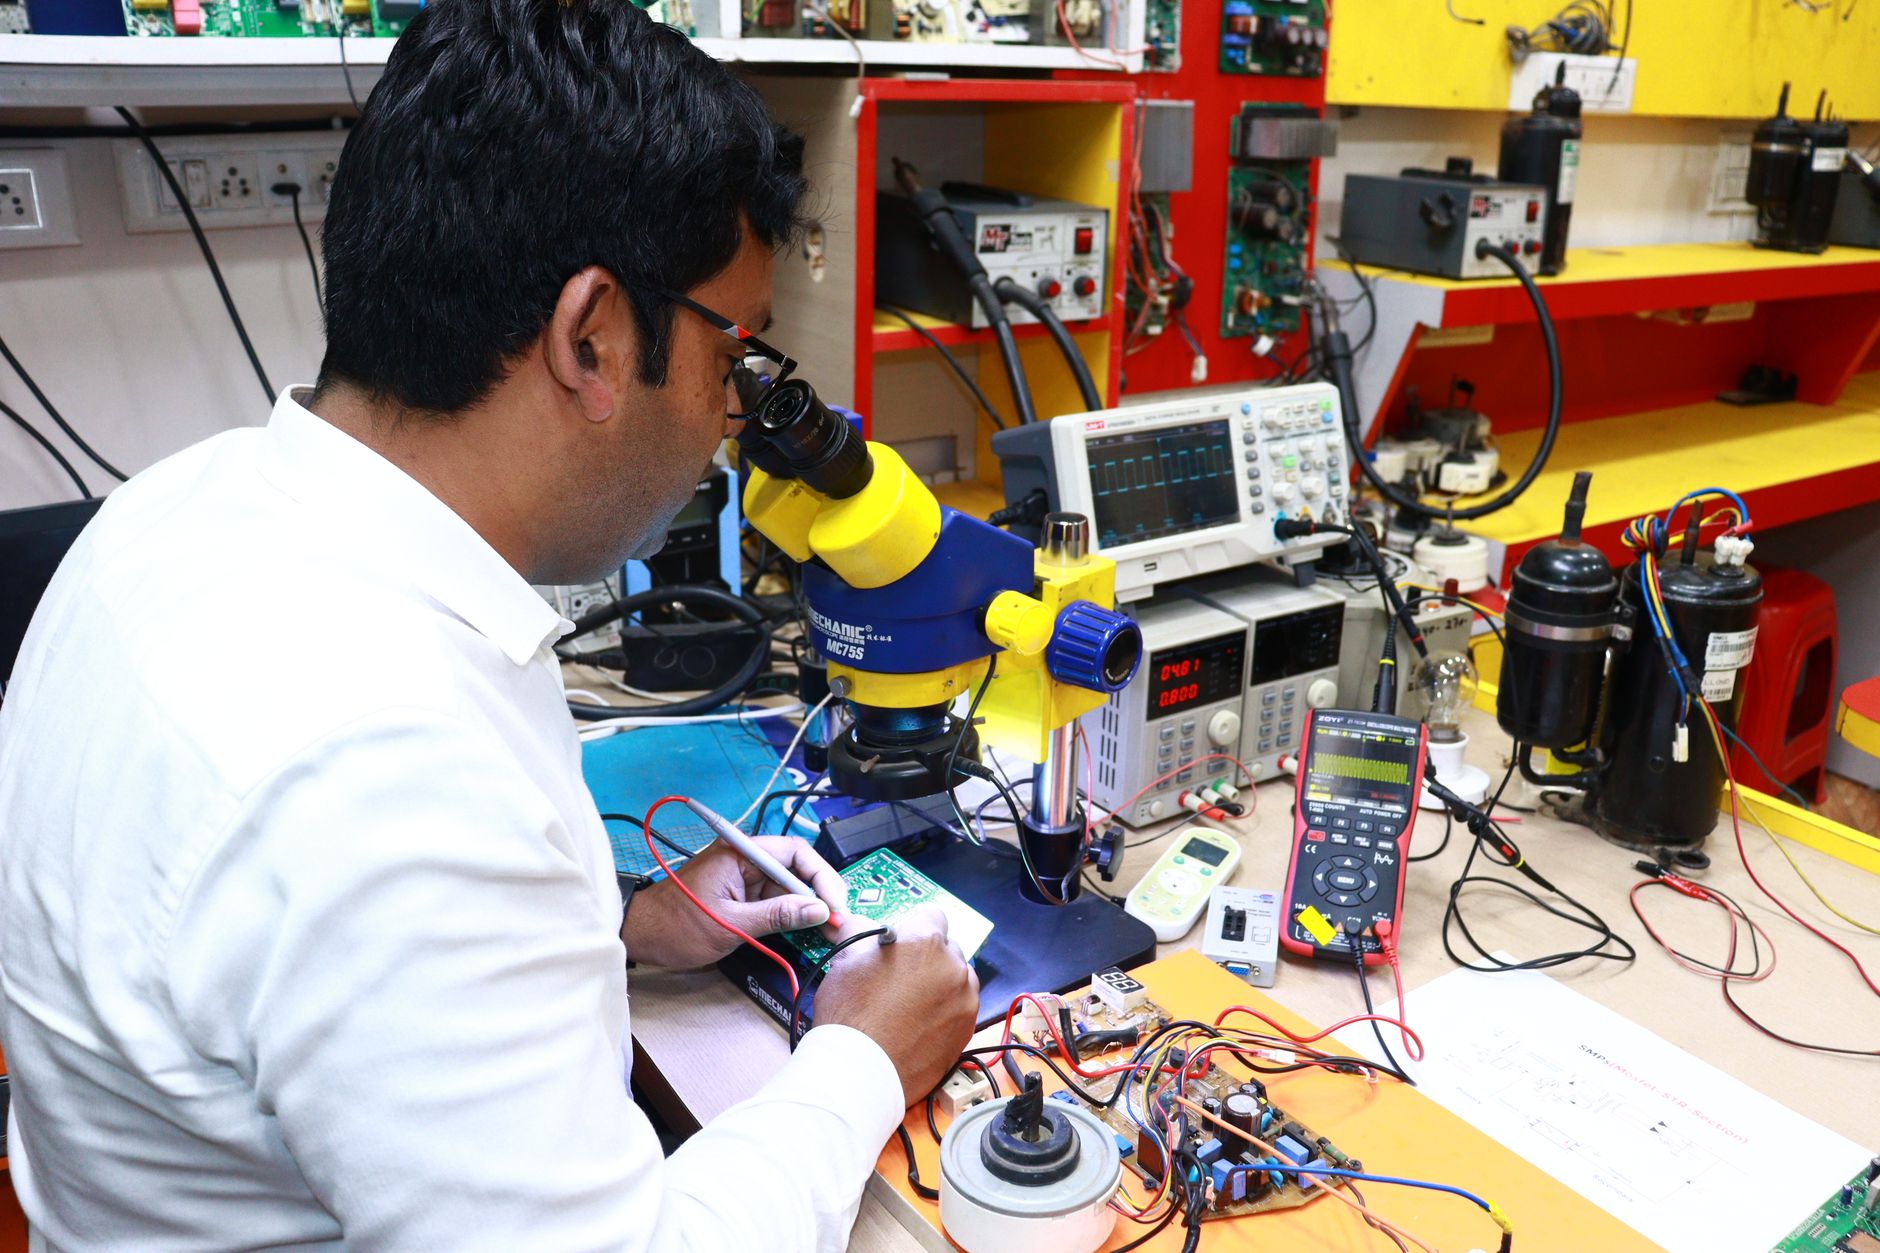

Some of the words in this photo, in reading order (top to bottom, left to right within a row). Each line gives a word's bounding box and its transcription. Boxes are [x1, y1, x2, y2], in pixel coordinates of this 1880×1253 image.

[826, 638, 865, 660] MC75S
[1318, 715, 1341, 723] ZOYI
[1325, 803, 1346, 811] COUNTS
[1373, 810, 1392, 818] POWER
[1337, 876, 1355, 884] MENU
